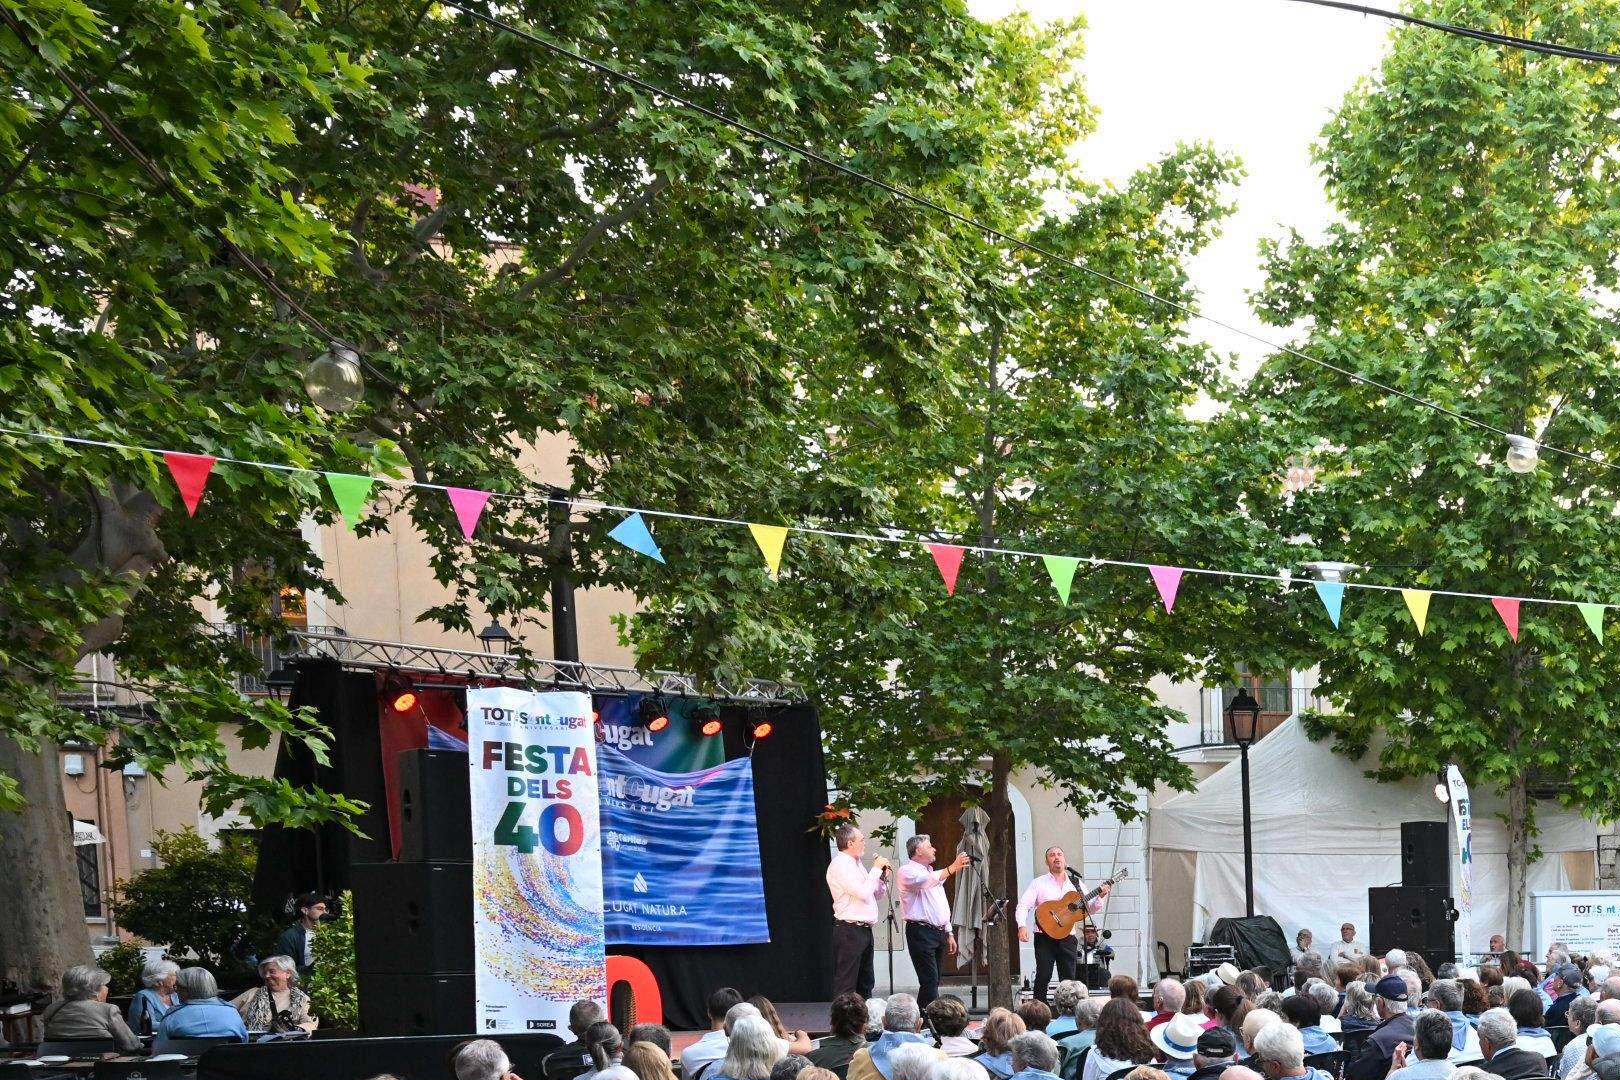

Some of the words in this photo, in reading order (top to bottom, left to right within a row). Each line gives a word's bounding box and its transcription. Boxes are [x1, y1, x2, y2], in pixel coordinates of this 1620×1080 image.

[480, 707, 514, 722] TOT
[483, 741, 592, 776] FESTA
[507, 776, 573, 799] DELS
[493, 802, 584, 857] 40
[641, 904, 688, 916] NATURA
[1572, 905, 1592, 914] TOT
